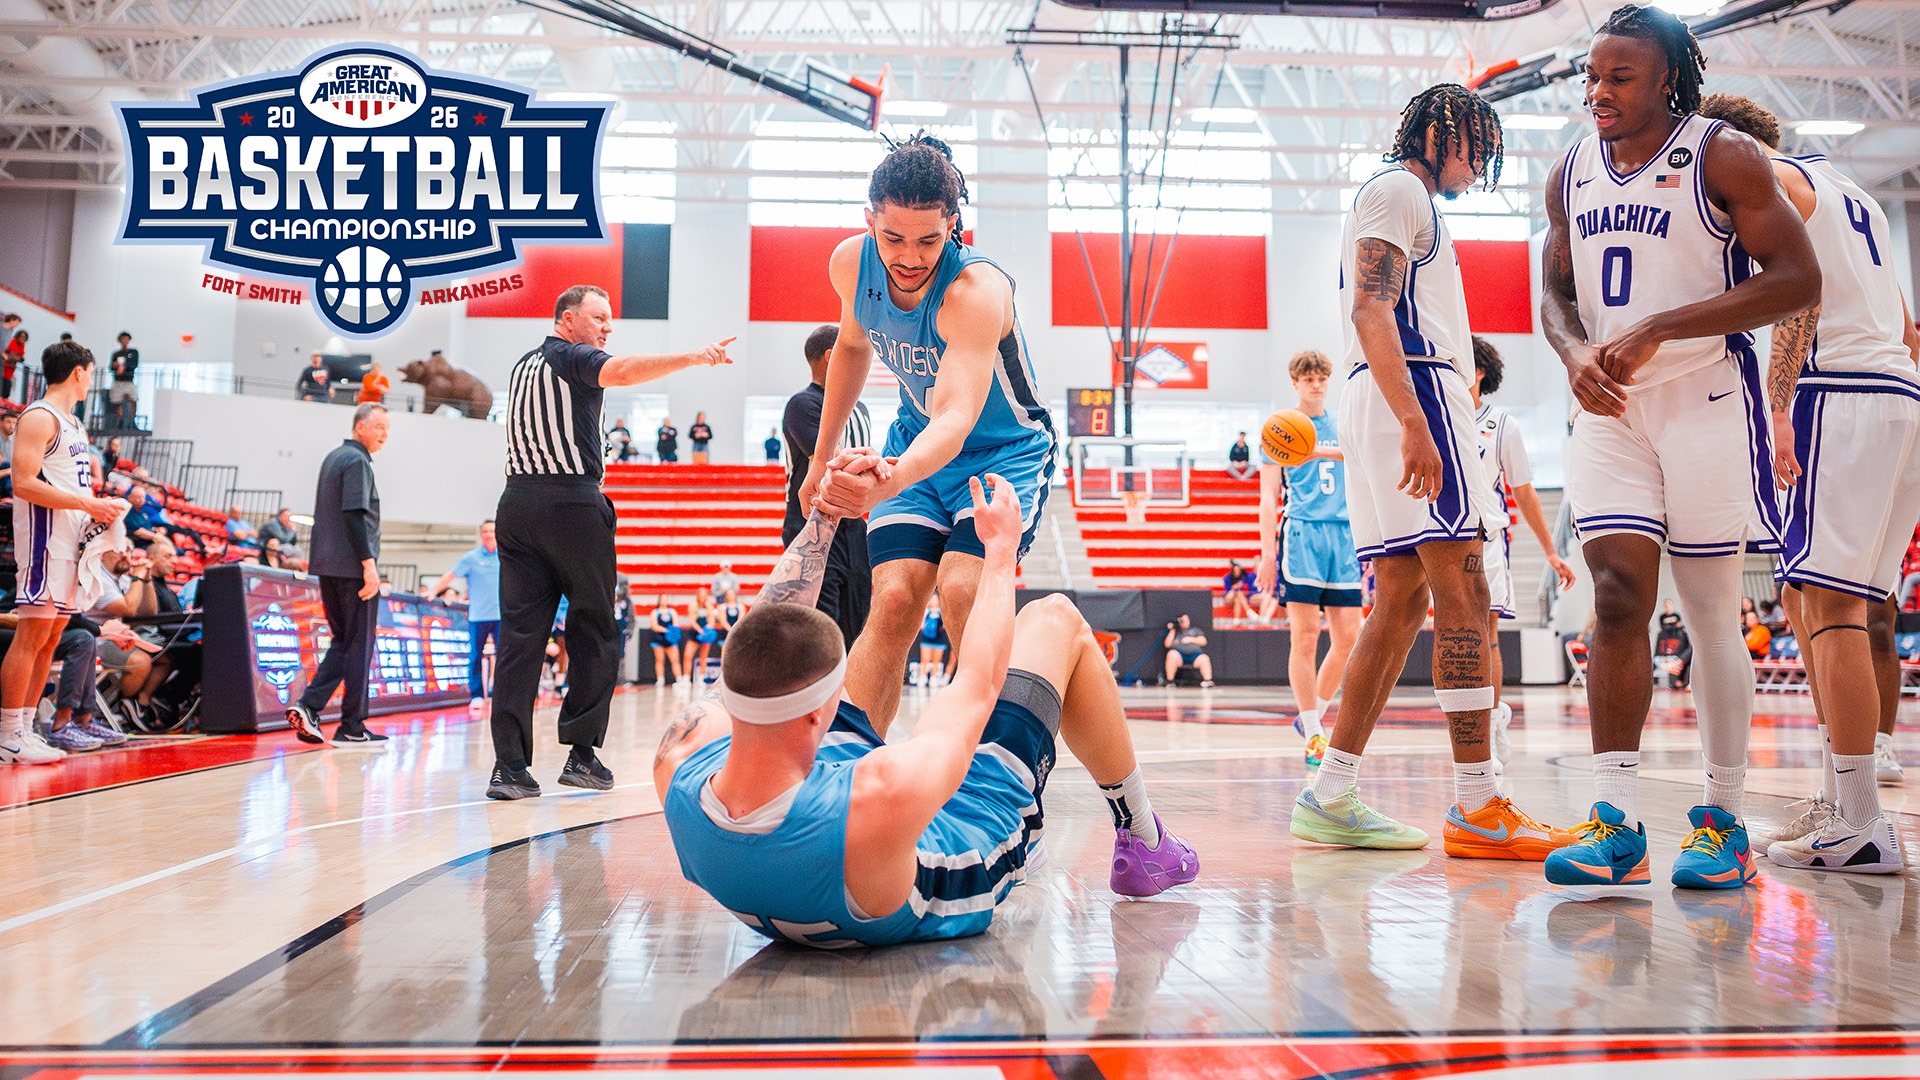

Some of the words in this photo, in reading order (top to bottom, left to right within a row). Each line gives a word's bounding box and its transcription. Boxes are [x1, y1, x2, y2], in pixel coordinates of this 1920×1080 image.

[1670, 153, 1692, 164] BV
[1576, 203, 1672, 240] OUACHITA
[1842, 192, 1882, 266] 4
[1601, 246, 1633, 307] 0
[867, 328, 940, 378] SWOSU
[1090, 407, 1108, 435] 8
[1270, 423, 1294, 445] NCAA
[1318, 461, 1336, 496] 5
[1439, 633, 1482, 646] Everything
[1441, 649, 1481, 660] Possible
